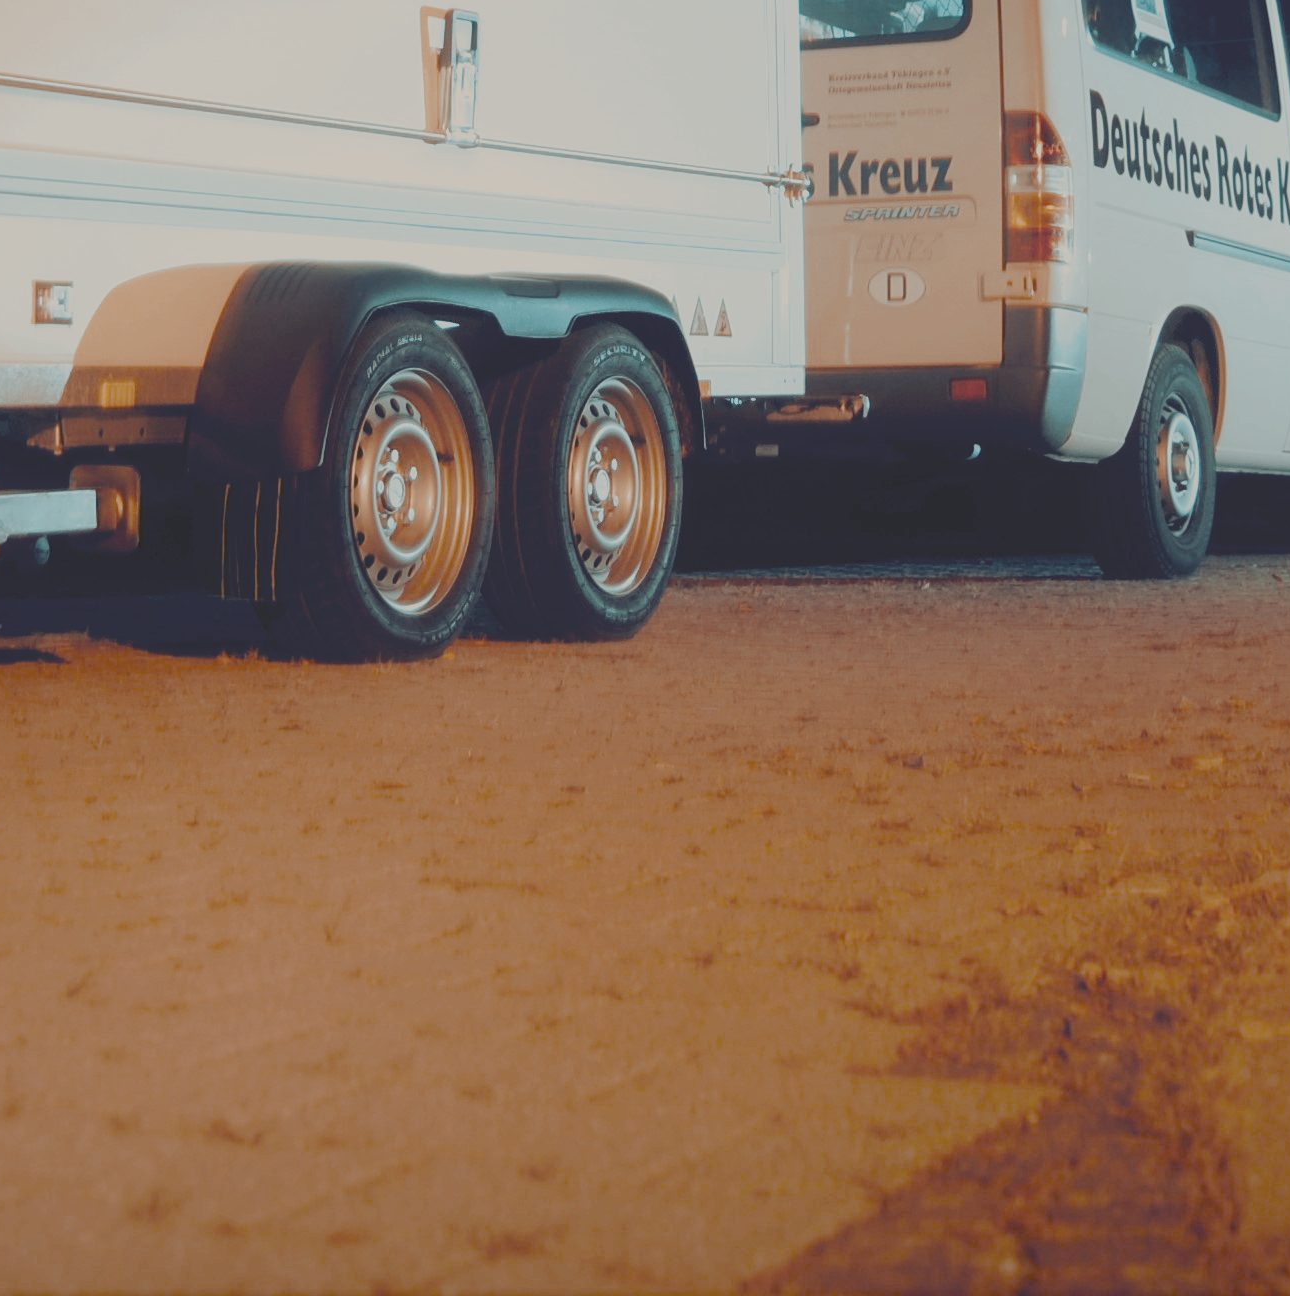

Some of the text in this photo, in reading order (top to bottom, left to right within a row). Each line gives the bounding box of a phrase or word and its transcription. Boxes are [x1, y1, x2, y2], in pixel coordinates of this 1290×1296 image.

[1089, 88, 1212, 202] Deutsches
[1215, 134, 1274, 221] Rotes
[828, 150, 953, 197] Kreuz
[844, 204, 960, 222] SPRINTER
[887, 272, 907, 301] D
[366, 343, 394, 379] RADIAL
[593, 344, 646, 367] SECURITY
